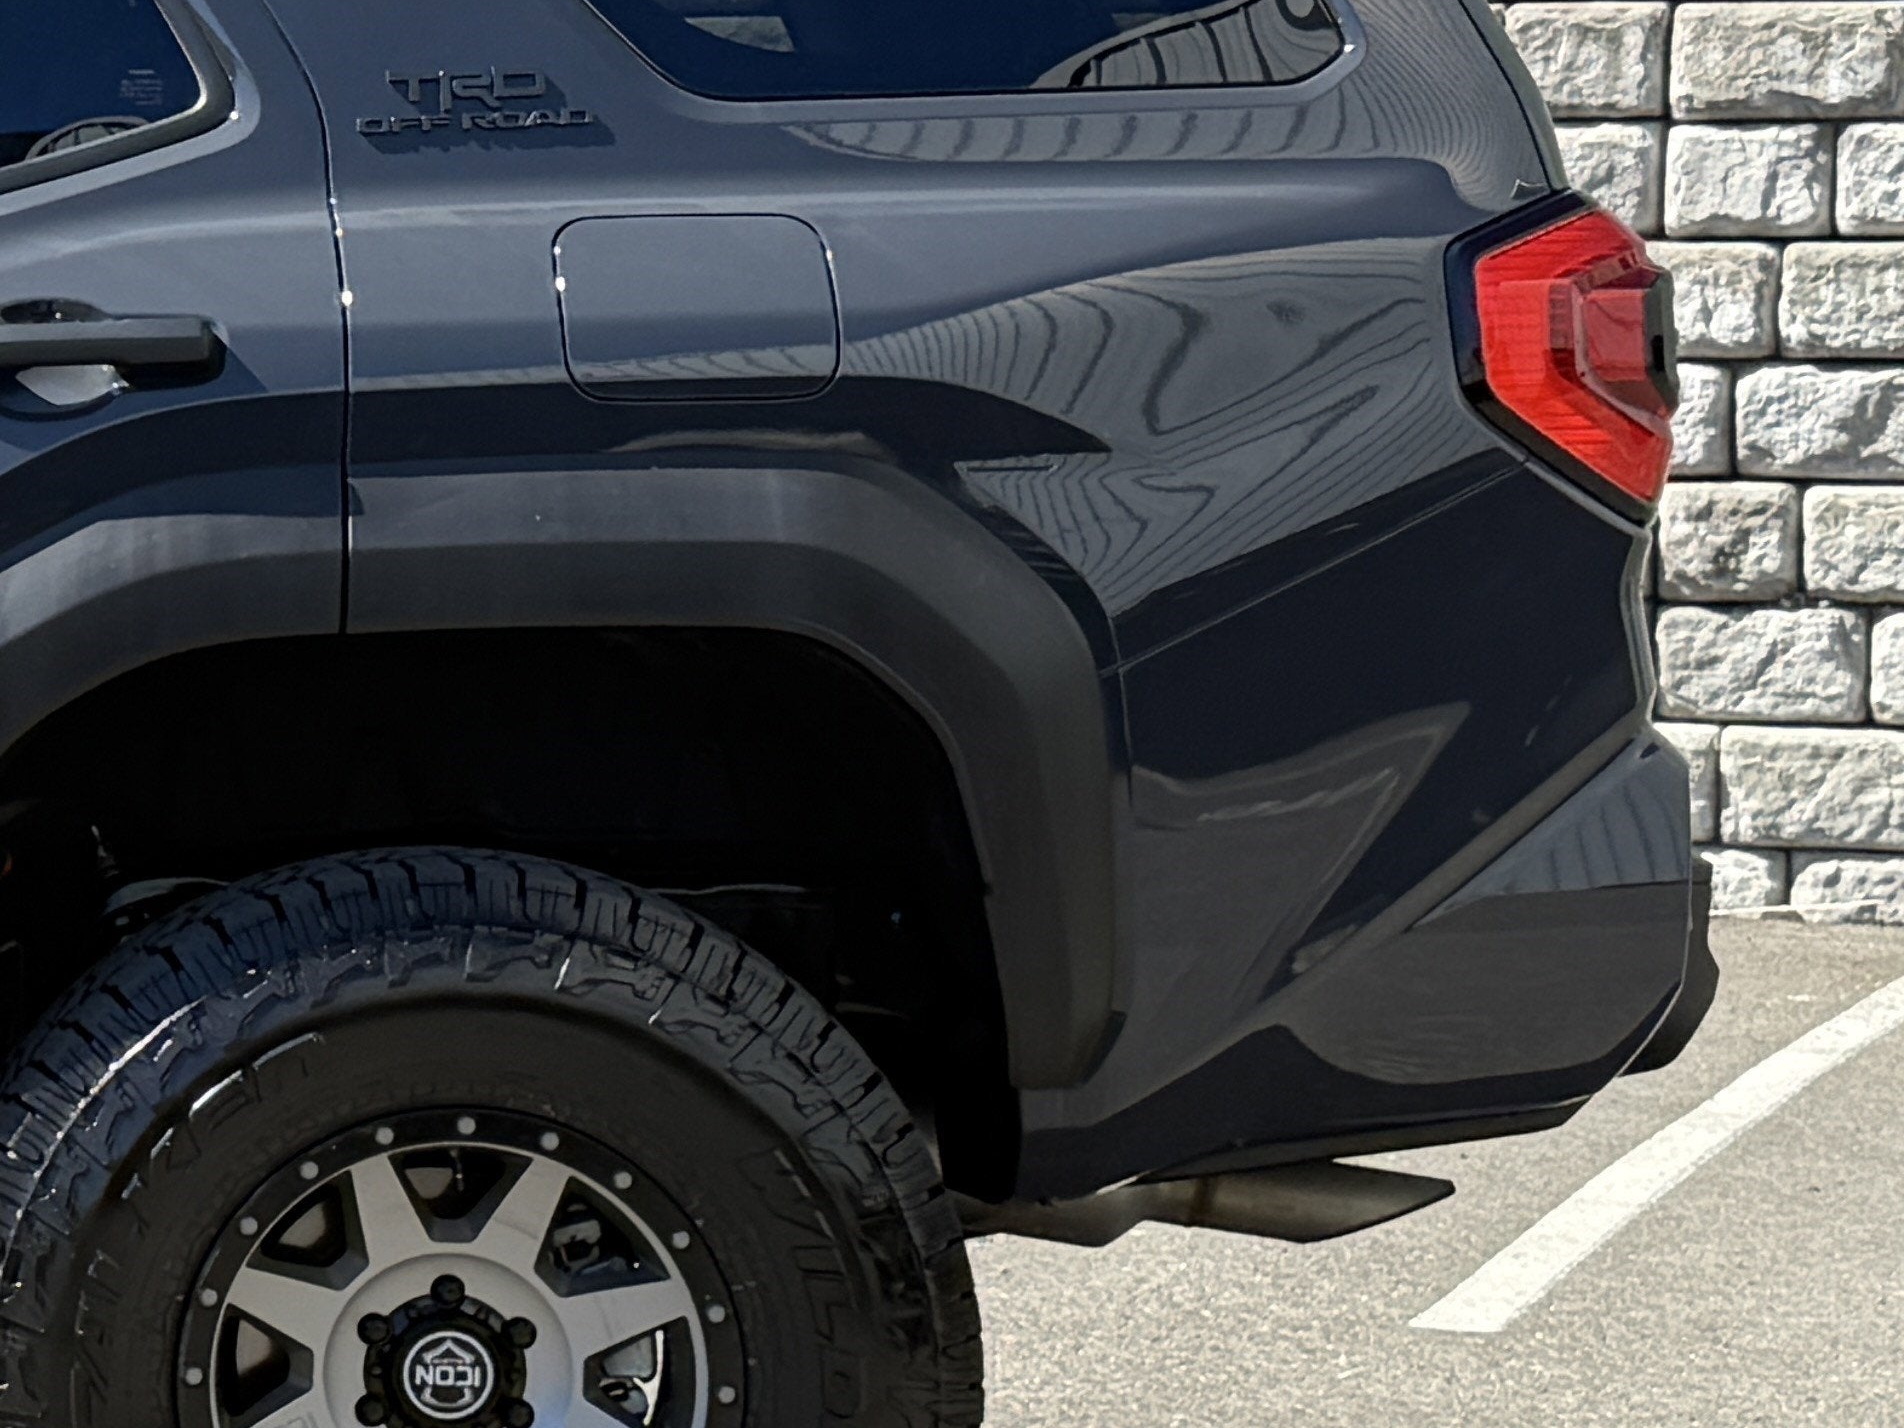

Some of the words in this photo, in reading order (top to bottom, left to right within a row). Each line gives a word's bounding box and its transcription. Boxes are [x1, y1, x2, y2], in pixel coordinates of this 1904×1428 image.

[385, 65, 547, 113] TRD
[356, 115, 453, 133] OFF
[461, 107, 593, 130] ROAD
[414, 1364, 482, 1388] ICON
